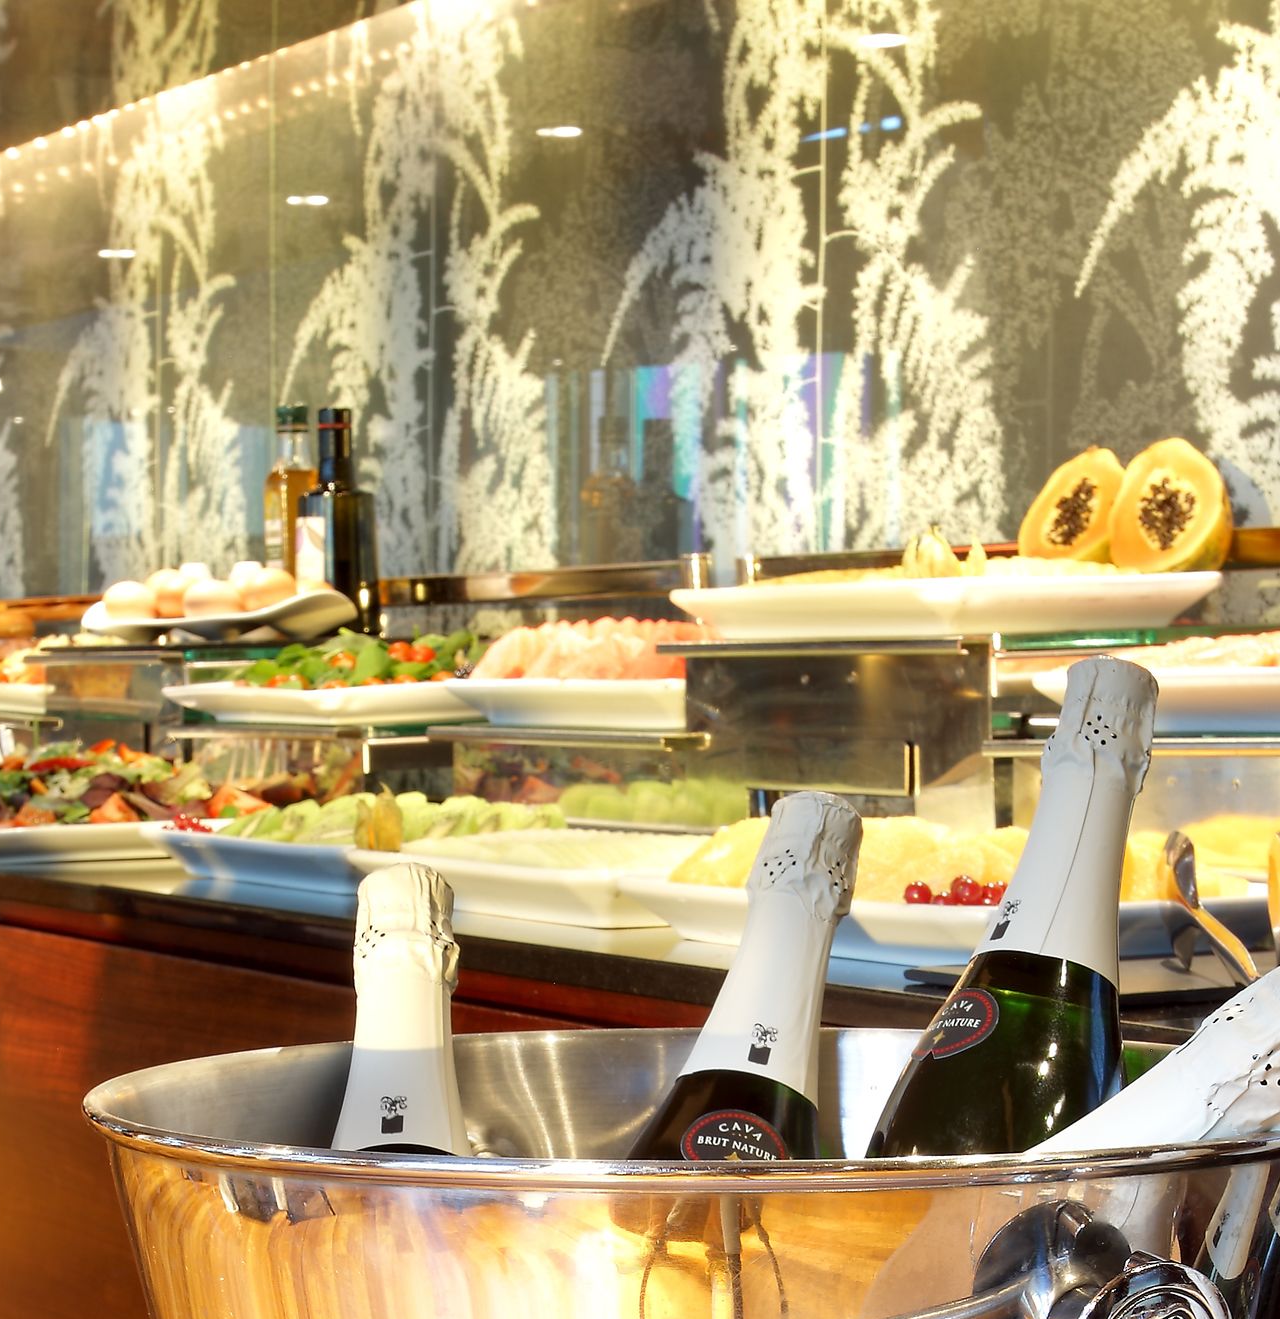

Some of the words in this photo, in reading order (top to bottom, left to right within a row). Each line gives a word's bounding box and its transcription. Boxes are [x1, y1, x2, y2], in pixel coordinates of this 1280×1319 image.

[942, 1017, 981, 1028] NATURE
[718, 1121, 763, 1141] CAVA
[697, 1135, 730, 1147] BRUT
